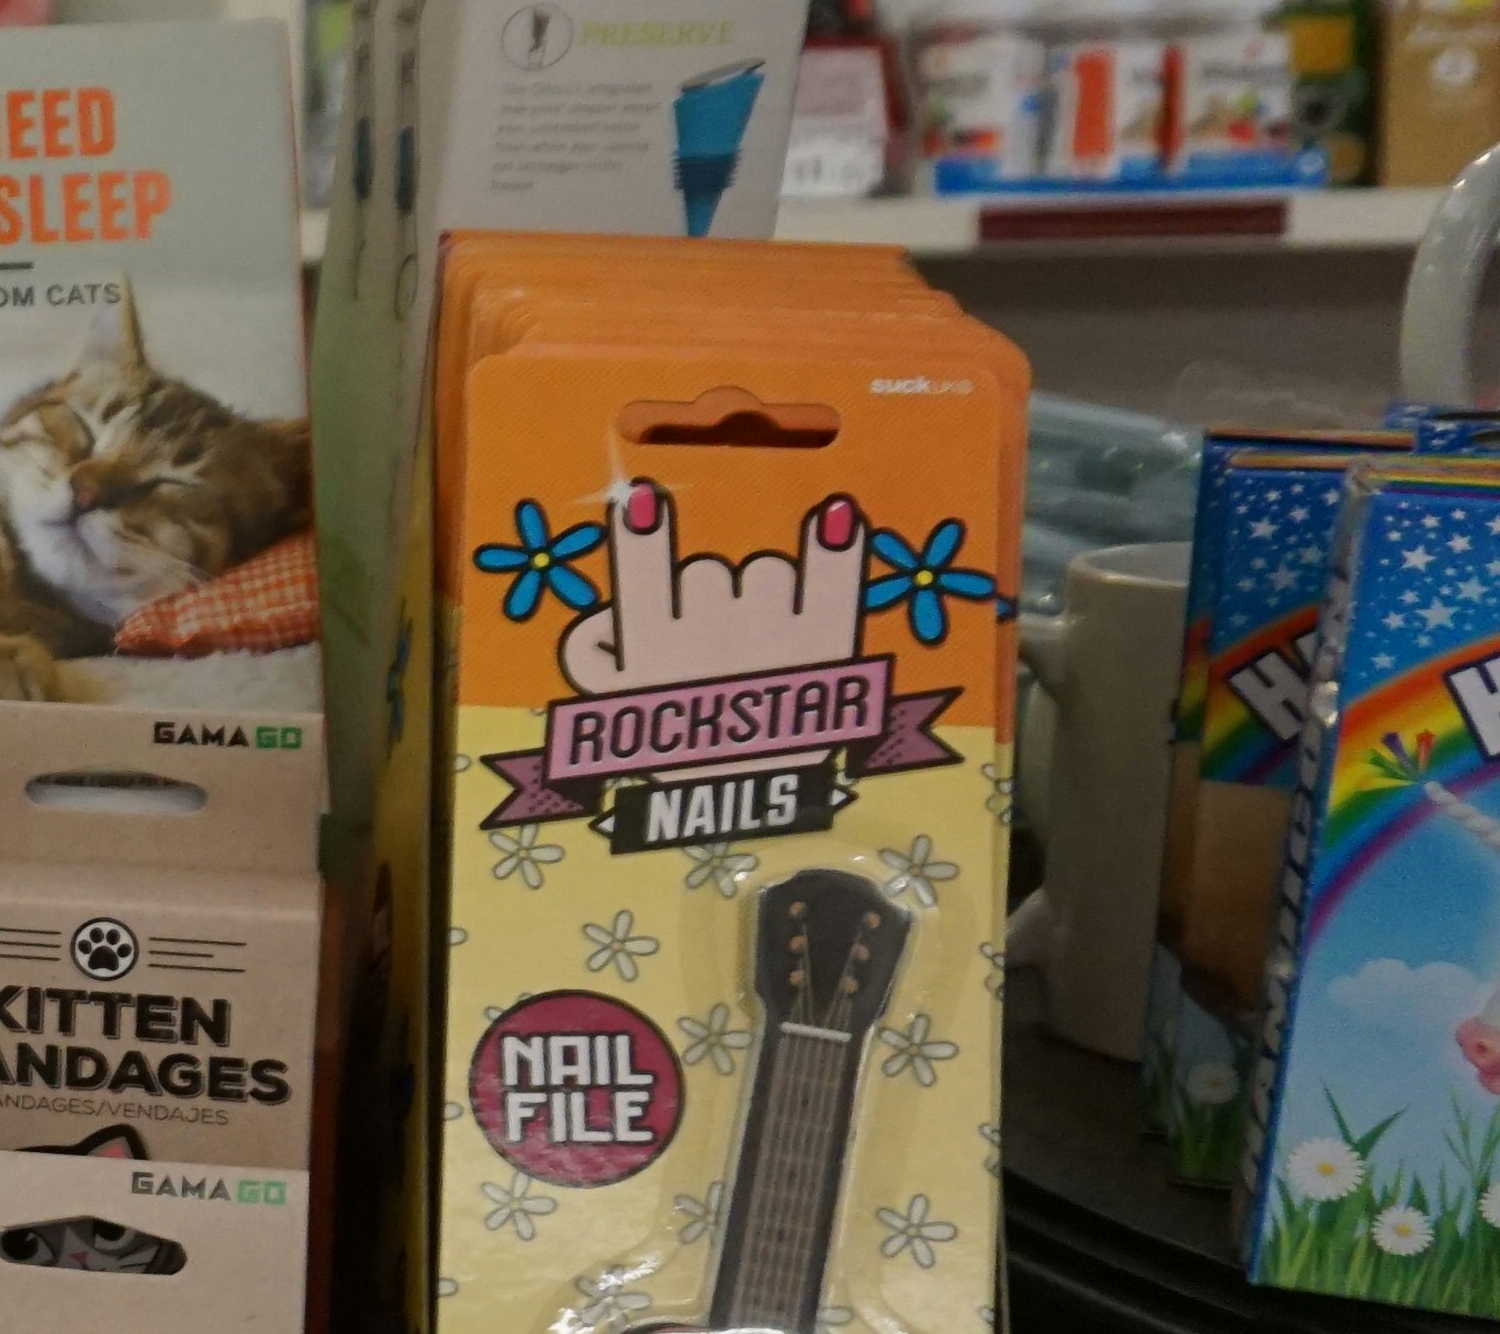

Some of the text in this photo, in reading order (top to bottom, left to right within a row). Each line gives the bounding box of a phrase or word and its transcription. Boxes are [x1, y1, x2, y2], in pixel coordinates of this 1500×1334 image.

[45, 282, 122, 307] CATS
[568, 670, 872, 767] ROCKSTAR
[644, 773, 801, 844] NAILS
[501, 1032, 656, 1091] NAIL
[504, 1091, 657, 1147] FILE
